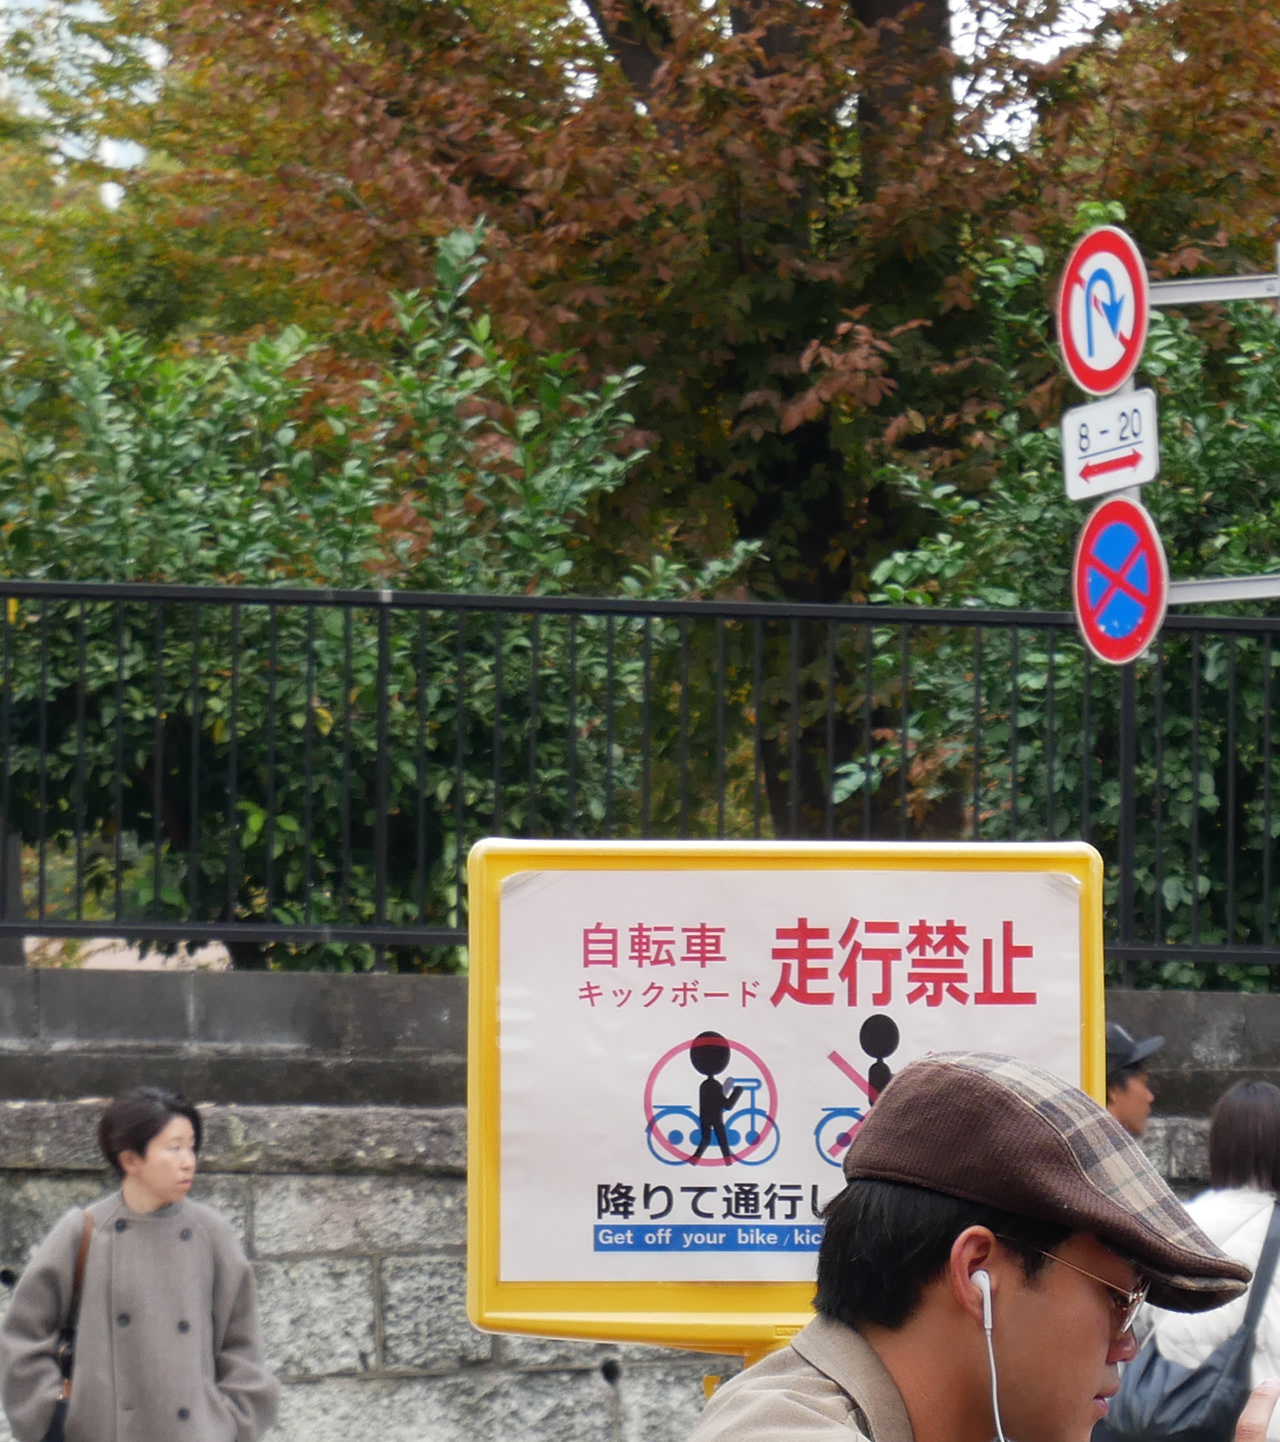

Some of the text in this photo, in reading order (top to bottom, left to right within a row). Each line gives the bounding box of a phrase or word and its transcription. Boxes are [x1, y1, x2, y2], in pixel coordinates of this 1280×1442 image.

[583, 921, 727, 969] 自転車
[769, 916, 1037, 1008] 走行禁止
[578, 979, 759, 1009] キックボード
[598, 1228, 634, 1245] Get
[645, 1228, 672, 1245] off
[682, 1231, 727, 1248] your
